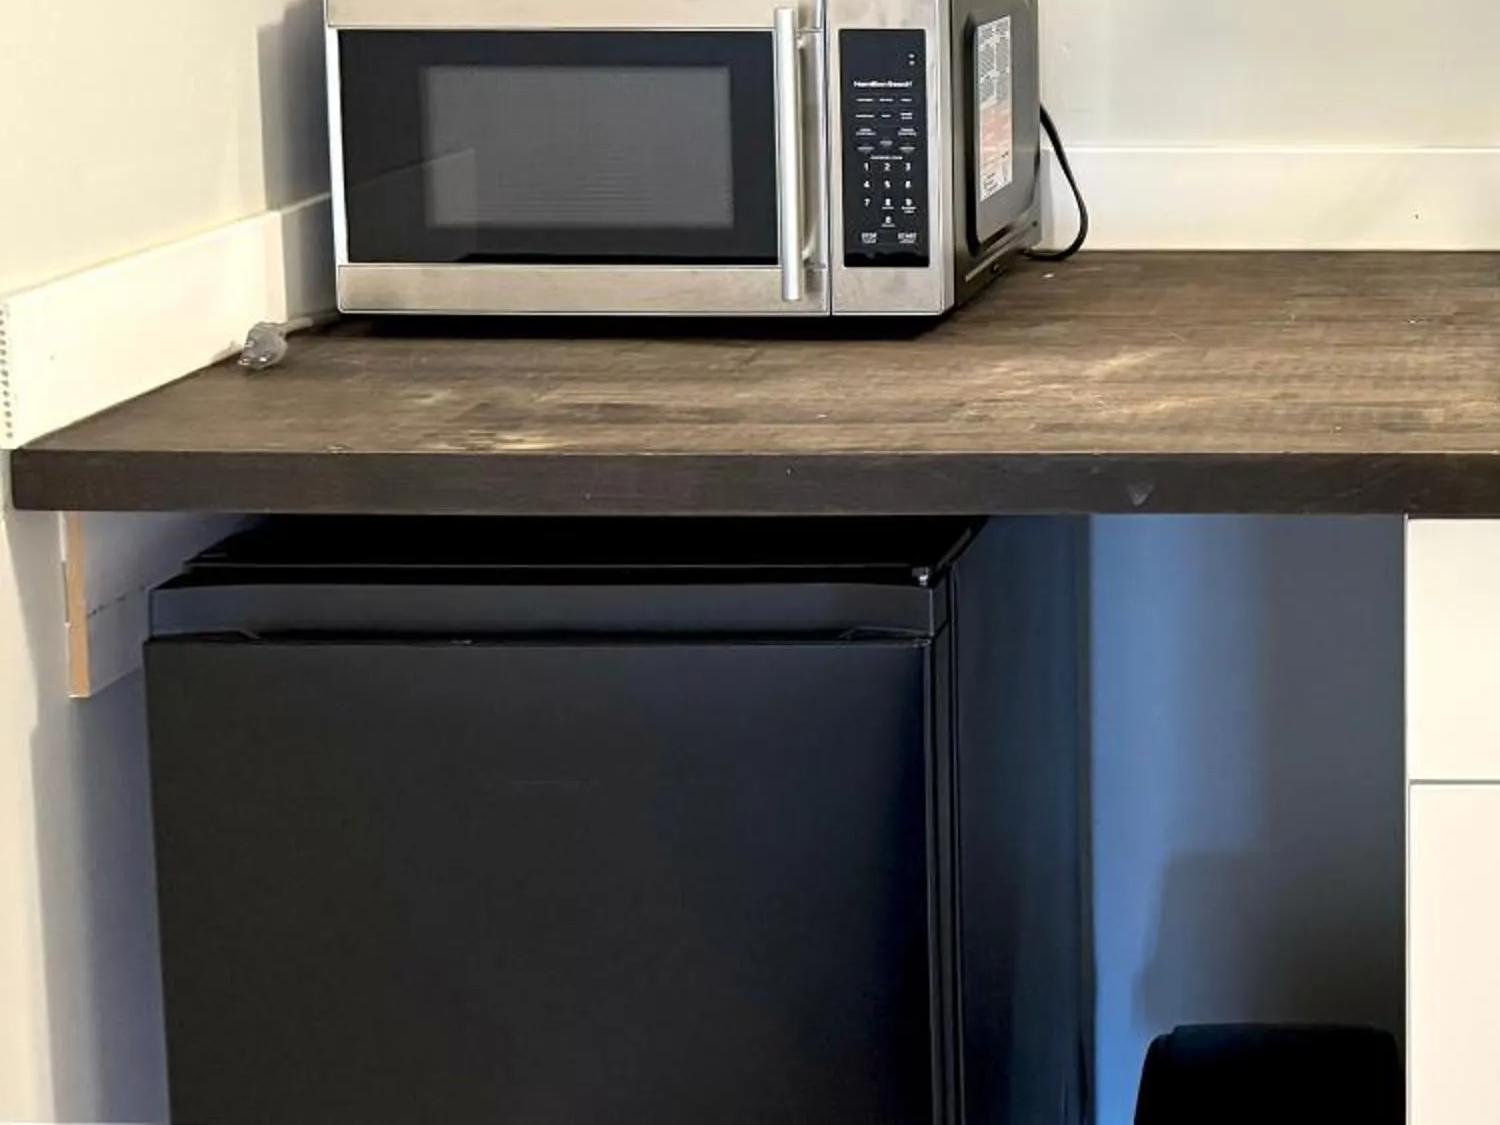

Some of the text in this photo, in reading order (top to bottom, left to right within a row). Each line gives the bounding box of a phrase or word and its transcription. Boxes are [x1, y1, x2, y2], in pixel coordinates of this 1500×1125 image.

[864, 162, 911, 172] 1 2 3
[863, 180, 871, 189] 4
[884, 180, 891, 189] 5
[864, 198, 871, 207] 7
